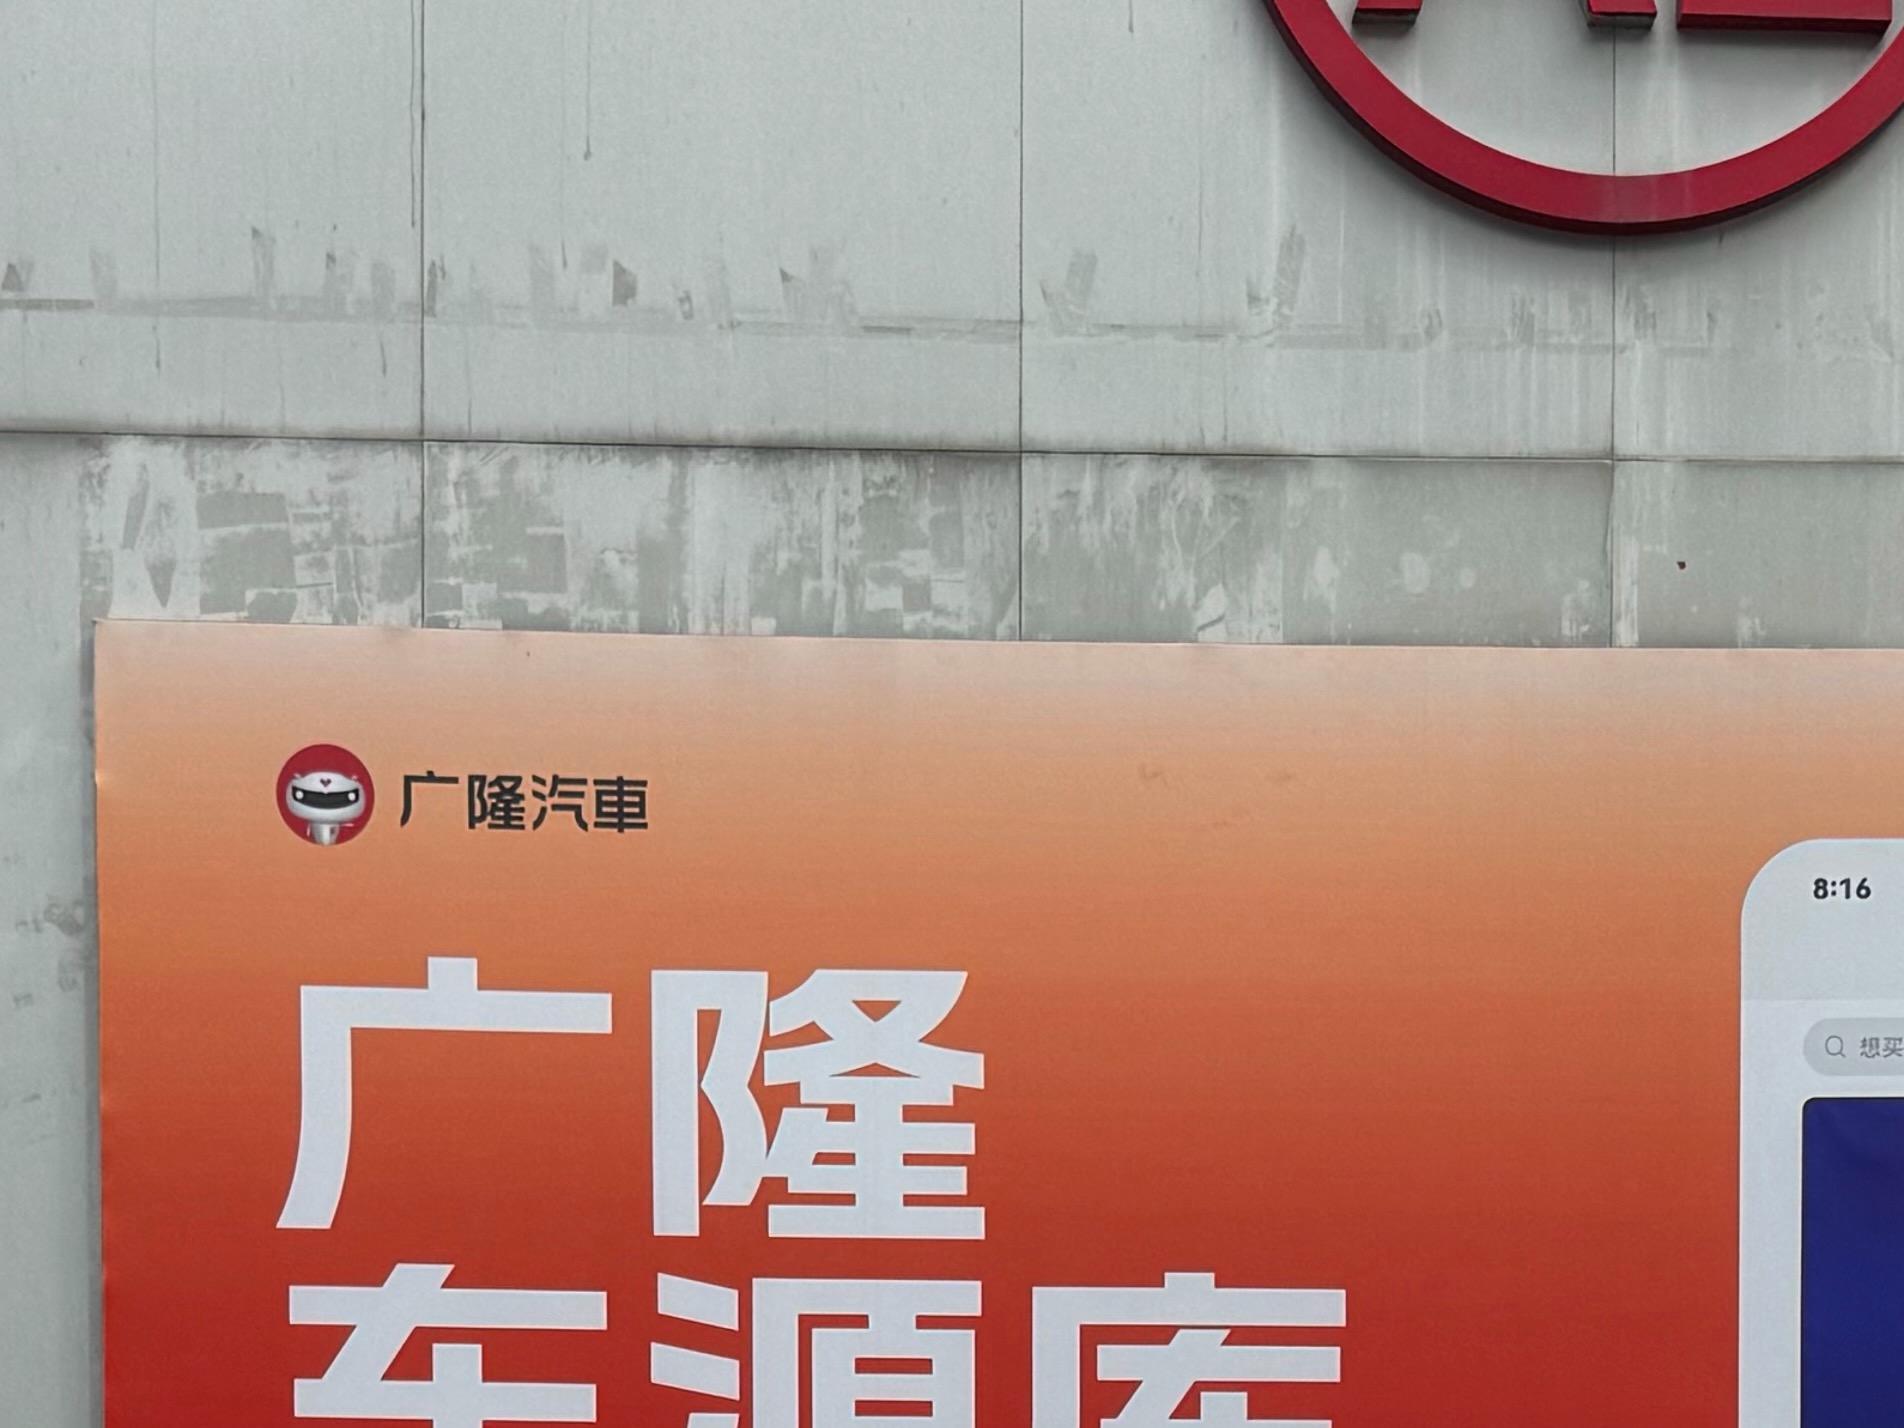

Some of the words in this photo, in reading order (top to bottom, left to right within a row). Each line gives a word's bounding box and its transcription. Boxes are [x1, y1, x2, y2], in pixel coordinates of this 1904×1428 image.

[399, 769, 649, 833] 广隆汽車
[1814, 878, 1871, 899] 8:16
[276, 956, 985, 1240] 广隆
